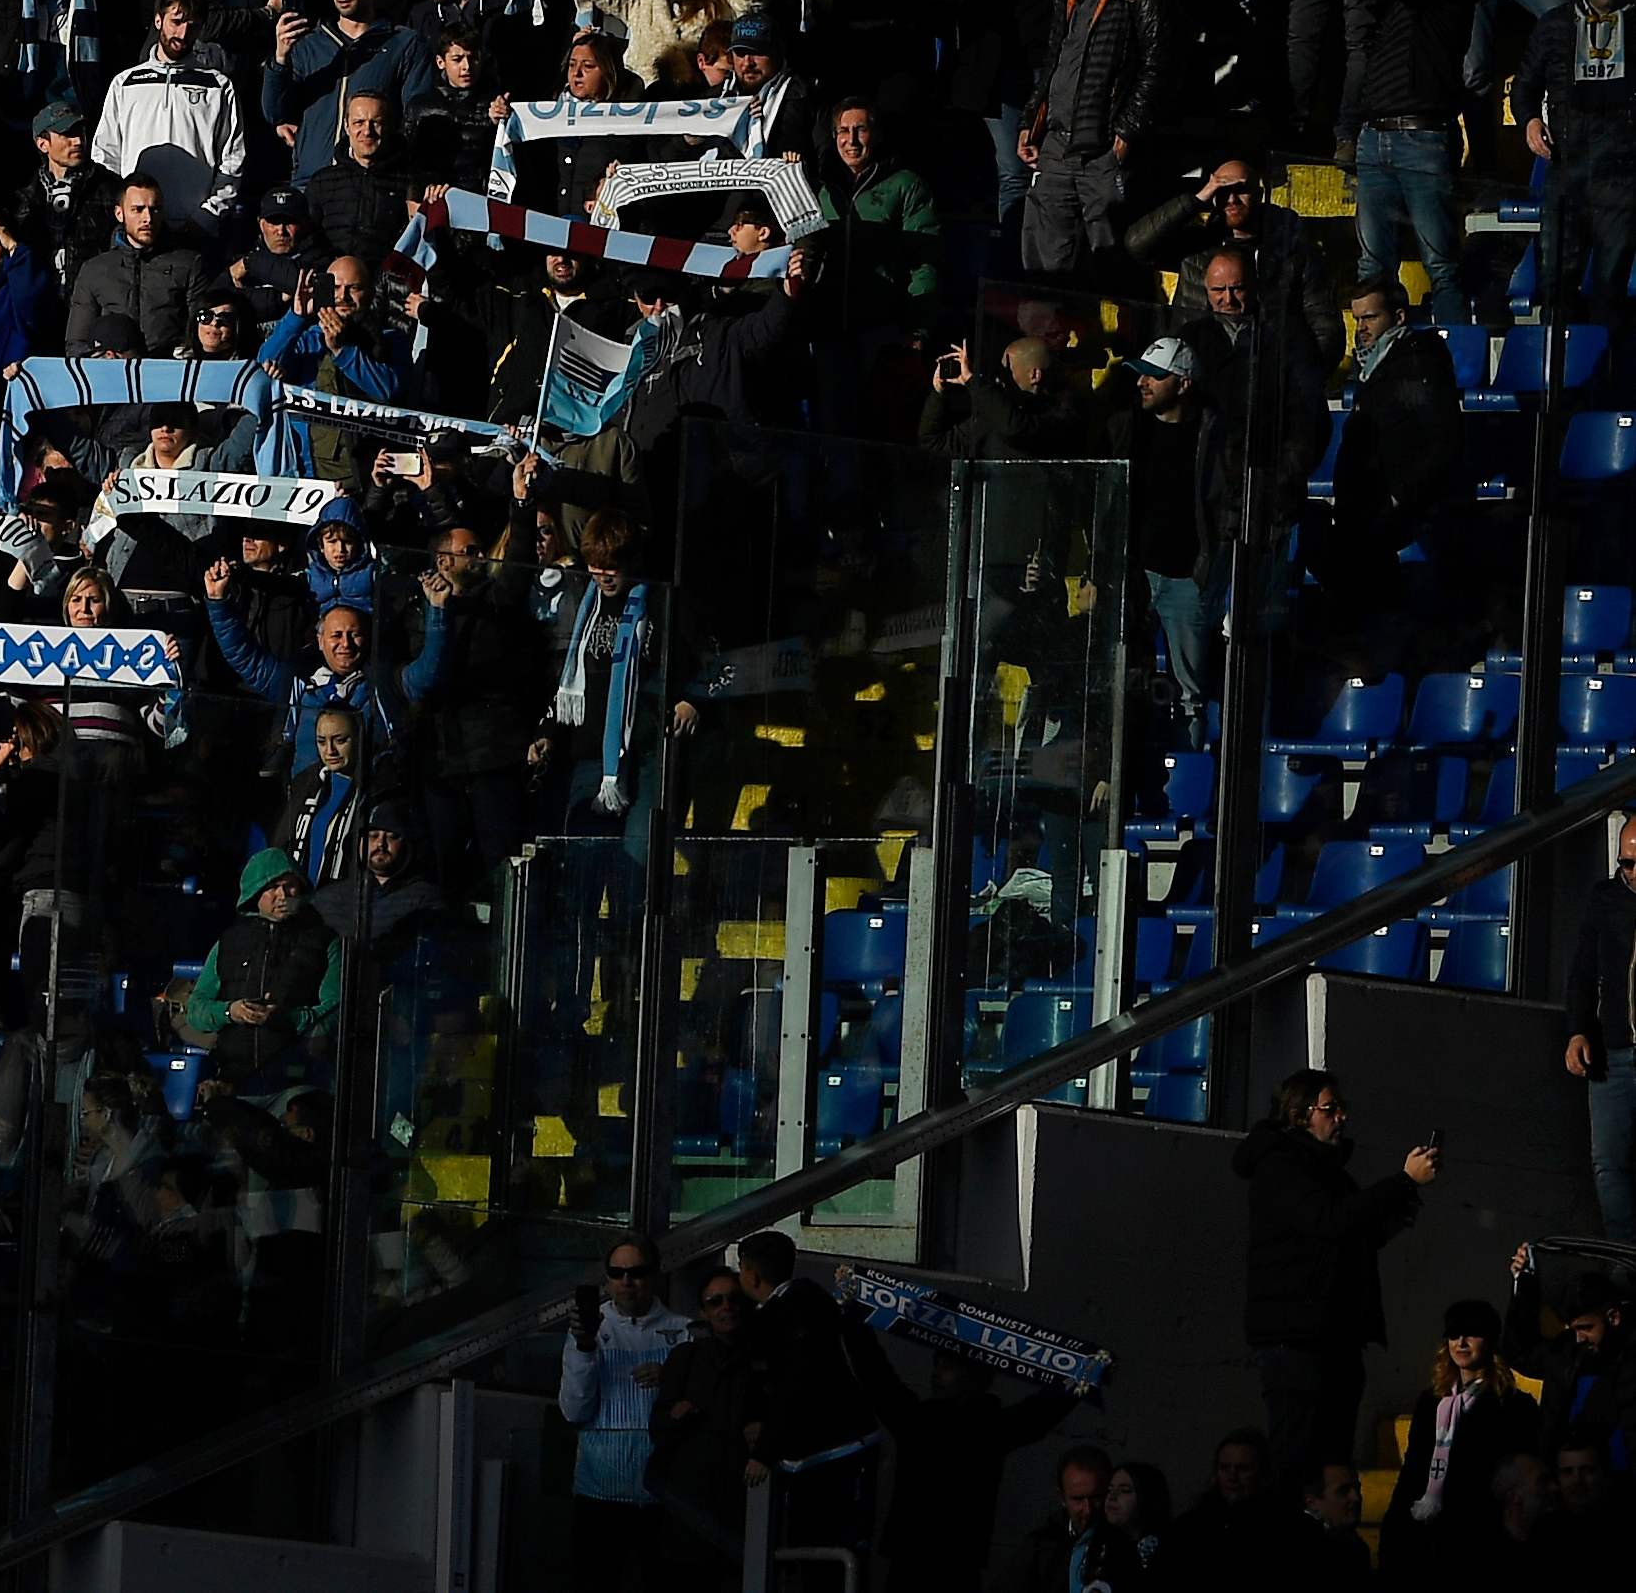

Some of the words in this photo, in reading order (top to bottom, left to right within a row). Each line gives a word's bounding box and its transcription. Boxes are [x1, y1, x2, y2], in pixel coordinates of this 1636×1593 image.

[529, 99, 660, 124] lazio
[675, 96, 727, 121] ss
[618, 162, 683, 183] S.S.
[281, 483, 326, 515] 19
[858, 1278, 960, 1336] FORZA
[980, 1314, 1078, 1371] LAZIO
[957, 1301, 1034, 1338] ROMANISTI
[1036, 1327, 1062, 1346] MAI
[966, 1346, 1009, 1369] LAZIO
[1014, 1362, 1036, 1378] OK
